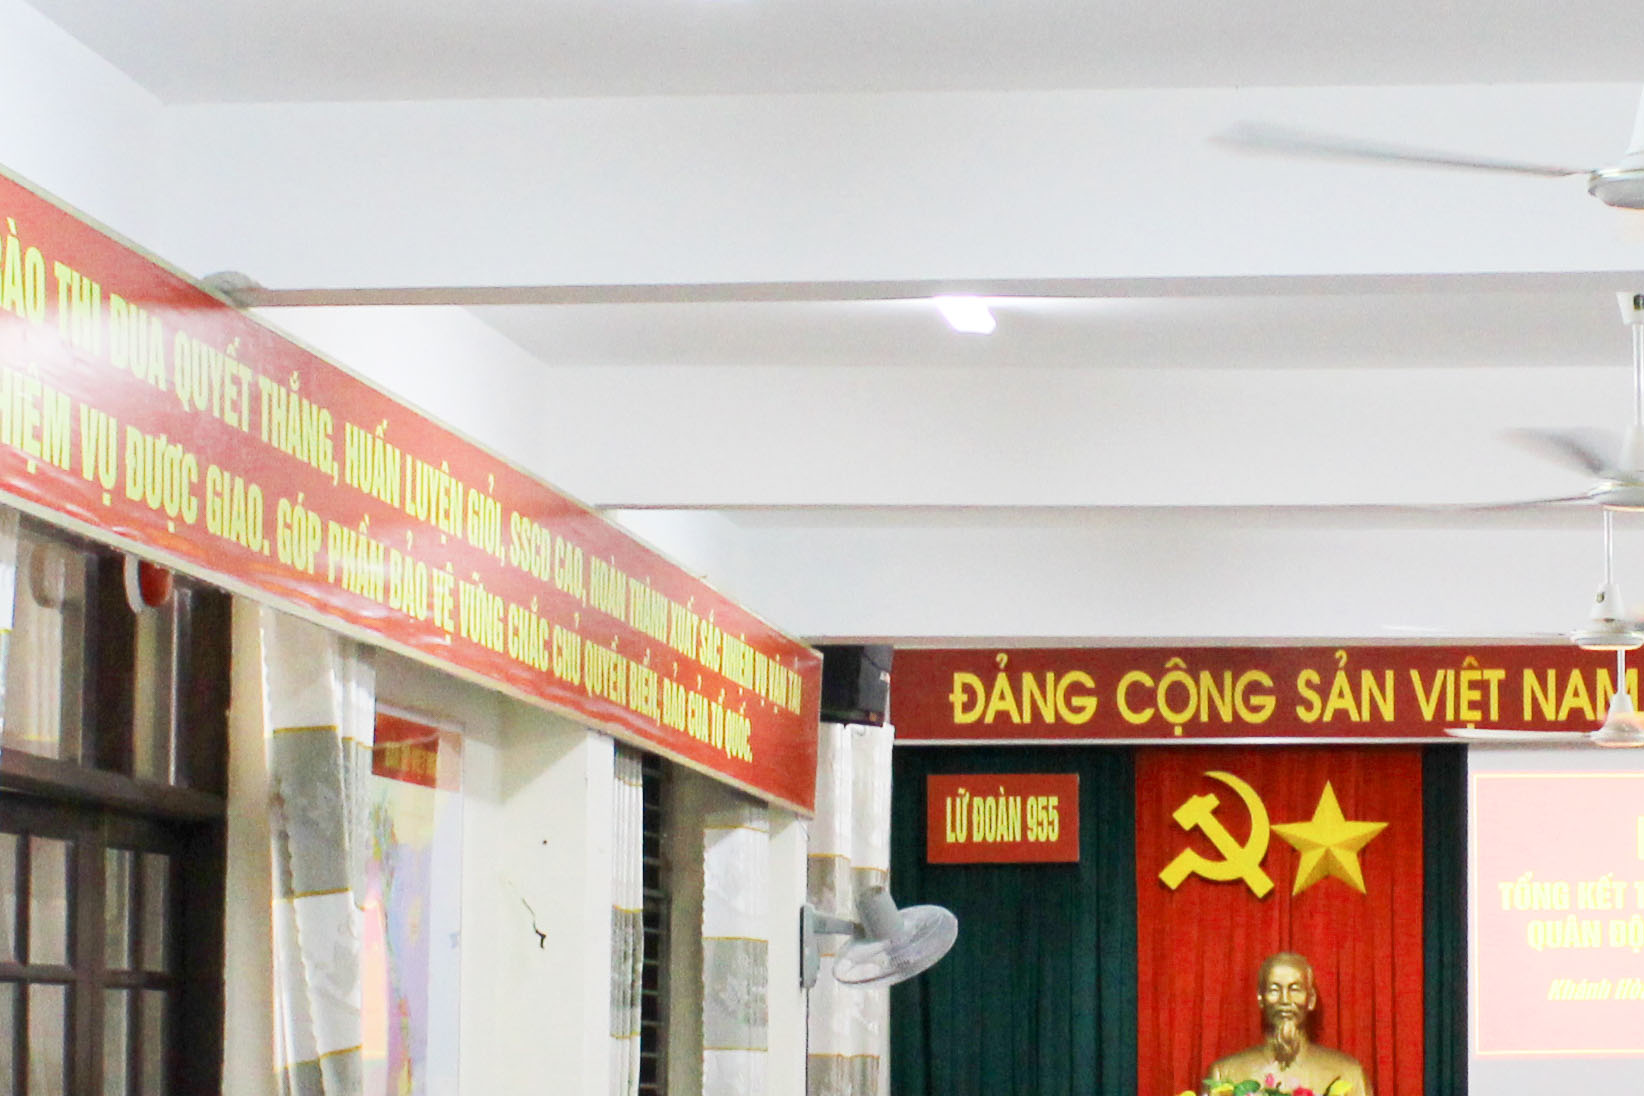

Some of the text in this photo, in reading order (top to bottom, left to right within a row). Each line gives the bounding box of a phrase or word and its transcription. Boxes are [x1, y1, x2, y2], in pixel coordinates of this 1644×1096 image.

[0, 216, 46, 326] ÀO
[54, 260, 101, 357] THI
[109, 292, 167, 392] ĐUA
[174, 330, 253, 433] QUYẾT
[258, 370, 339, 487] THẮNG,
[345, 418, 401, 509] HUẤN
[405, 452, 464, 544] LUYỆN
[467, 473, 506, 567] GIỎI,
[554, 535, 587, 608] CAO,
[590, 554, 627, 622] HOÀN
[629, 576, 668, 644] THÀNH
[669, 595, 699, 660] XUẤT
[699, 608, 721, 672] SẮC
[722, 631, 754, 695] NHIỆM
[755, 650, 768, 707] VỤ
[768, 653, 787, 714] VẬN
[80, 402, 118, 506] VỤ
[125, 425, 198, 533] ĐƯỢC
[206, 464, 271, 556] GIAO.
[277, 492, 322, 575] GÓP
[327, 513, 385, 604] PHẦN
[389, 529, 428, 621] BẢO
[432, 561, 455, 643] VỆ
[459, 571, 504, 653] VỮNG
[508, 595, 549, 672] CHẮC
[552, 612, 581, 686] CHỦ
[584, 634, 627, 706] QUYỀN
[629, 647, 660, 727] BIỂN,
[662, 661, 686, 732] ĐẢO
[687, 674, 709, 743] CỦA
[711, 687, 725, 750] TỔ
[725, 701, 753, 763] QUỐC.
[949, 653, 1098, 724] ĐẢNG
[1116, 657, 1277, 736] CỘNG
[1296, 650, 1395, 722] SẢN
[1410, 655, 1505, 728] VIỆT
[946, 786, 1060, 843] LỮ ĐOÀN 955
[1577, 872, 1628, 910] KẾT
[1527, 913, 1602, 951] QUÂN
[1547, 977, 1612, 1001] Khánh
